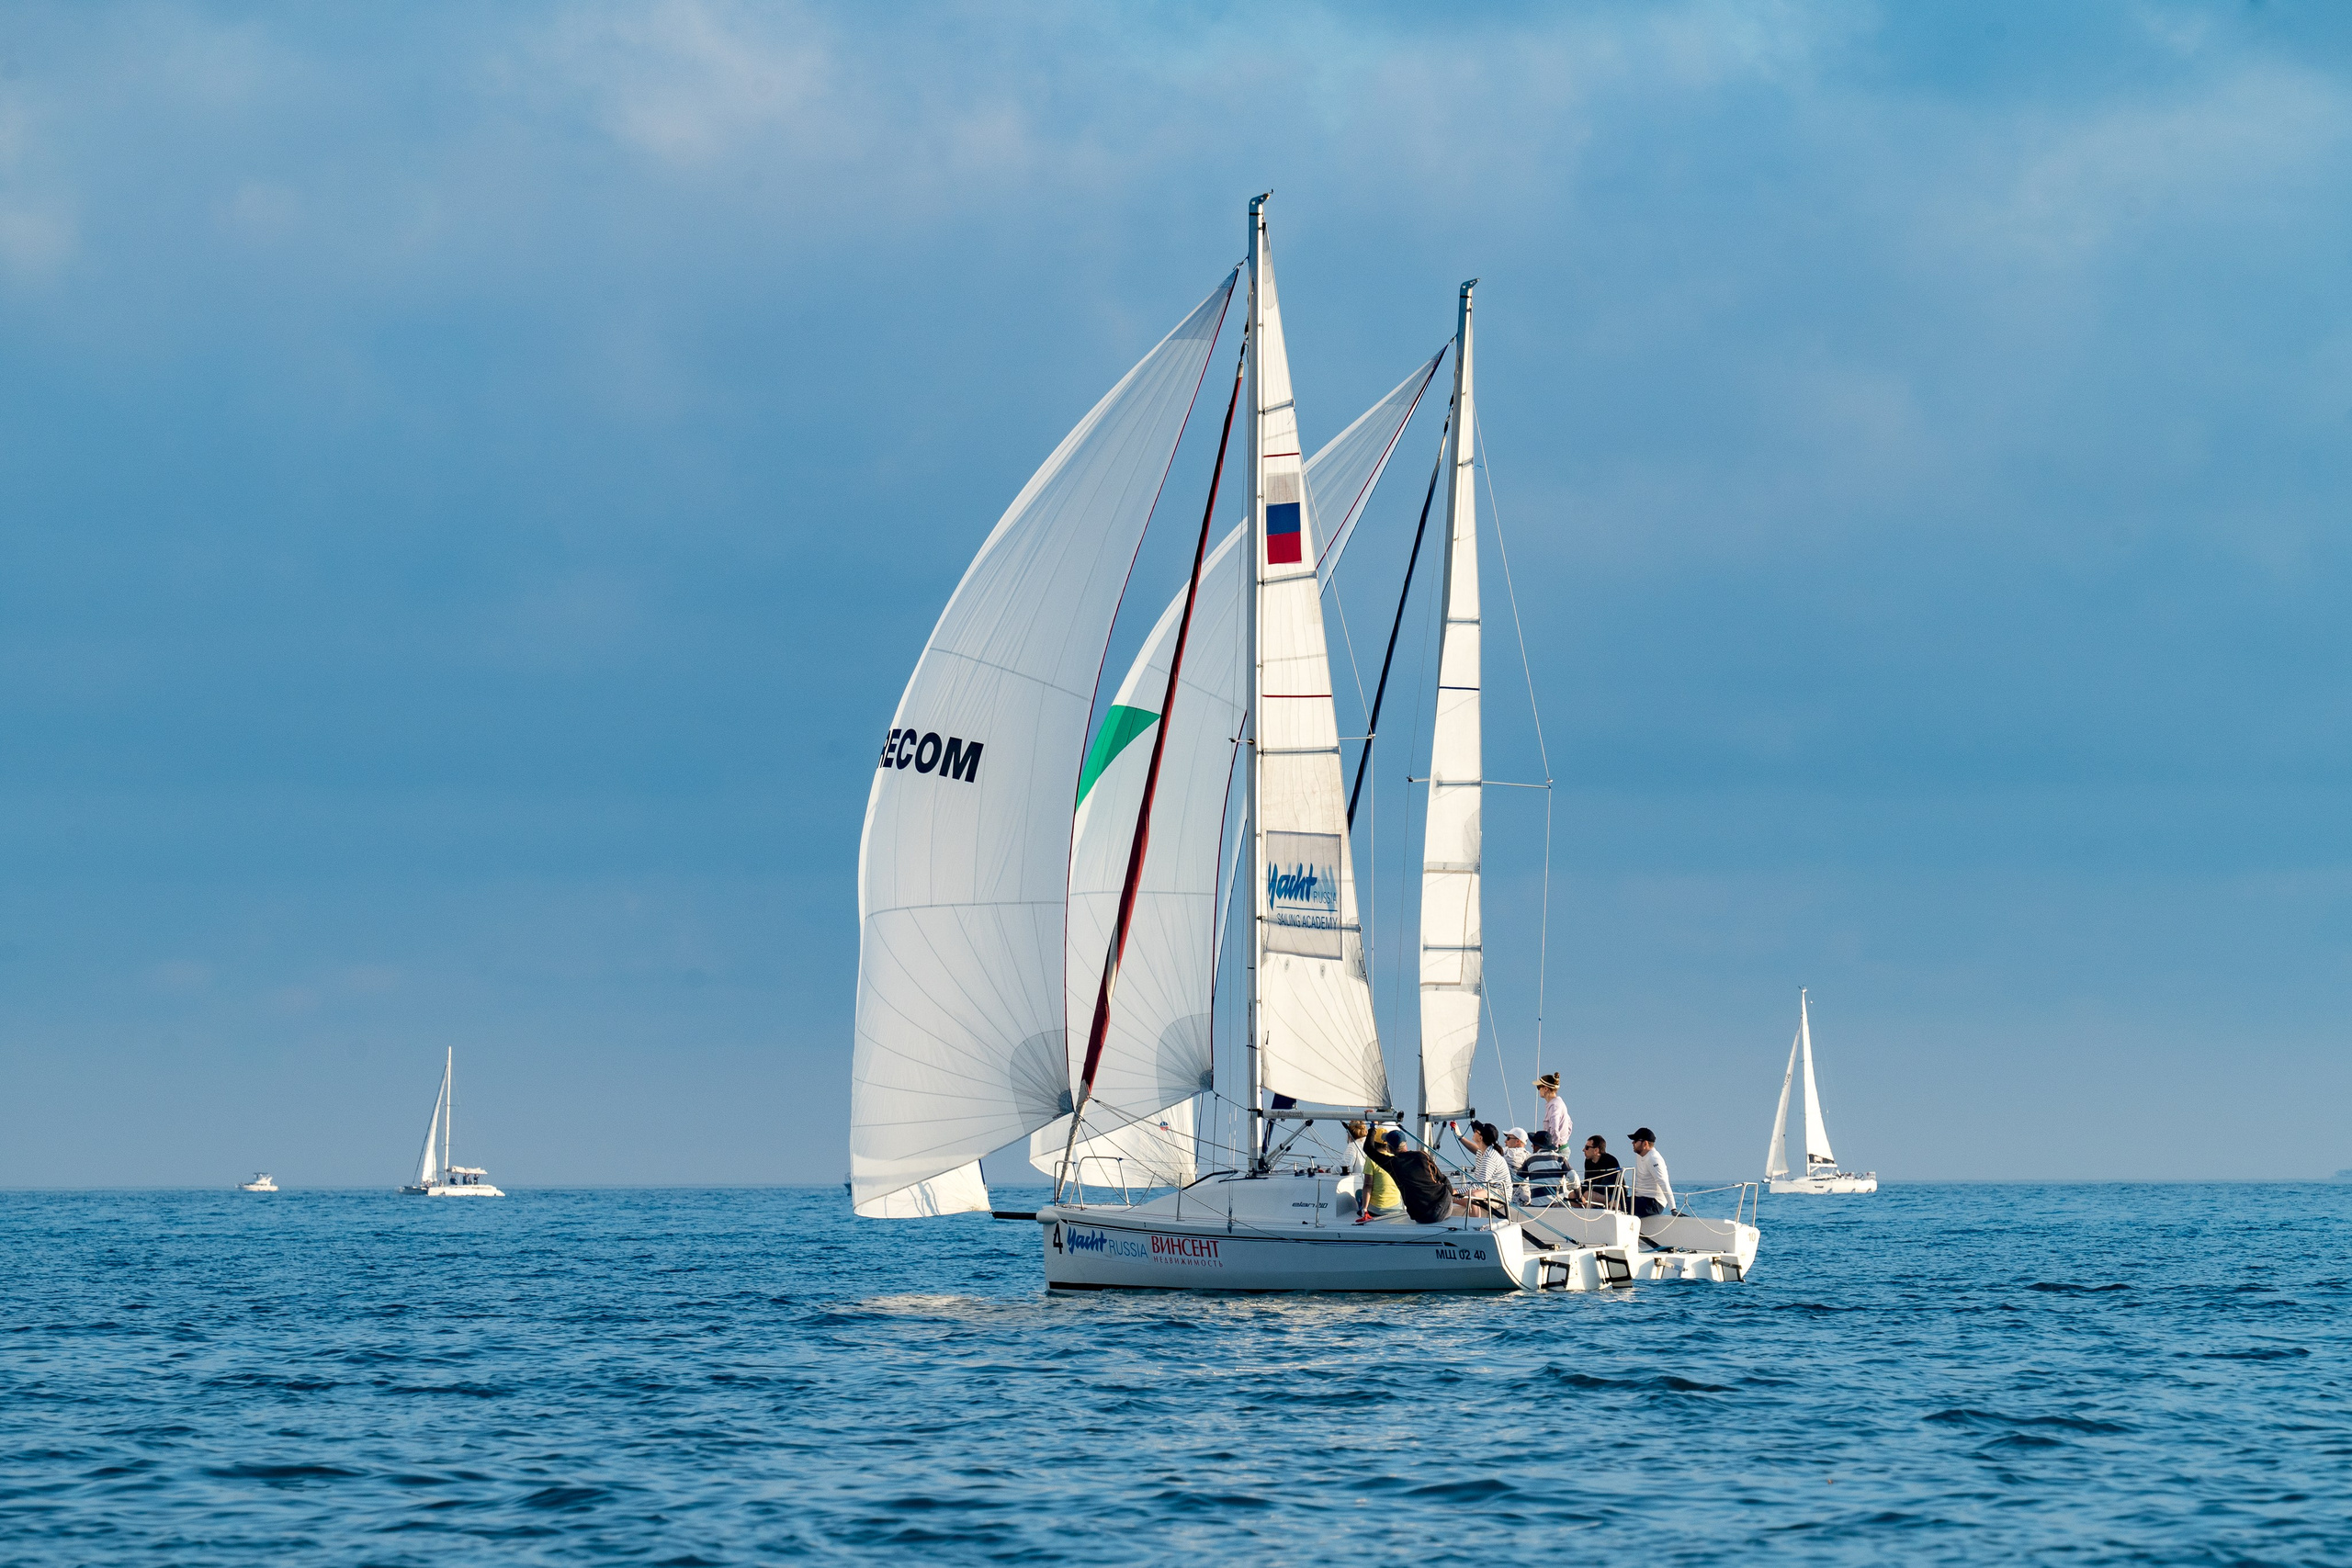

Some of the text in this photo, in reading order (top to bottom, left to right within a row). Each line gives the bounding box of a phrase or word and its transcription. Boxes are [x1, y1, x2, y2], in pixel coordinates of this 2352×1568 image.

[1313, 890, 1337, 904] RUSSIA
[1276, 913, 1338, 930] SAILING ACADEMY
[1053, 1223, 1063, 1255] 4
[1067, 1226, 1148, 1258] Yacht RUSSIA
[1747, 1232, 1757, 1242] 10
[1151, 1235, 1219, 1258] ВИНСЕНТ
[1153, 1256, 1224, 1268] НЕДВИЖИМОСТЬ
[1435, 1249, 1486, 1260] МЩ 02 40
